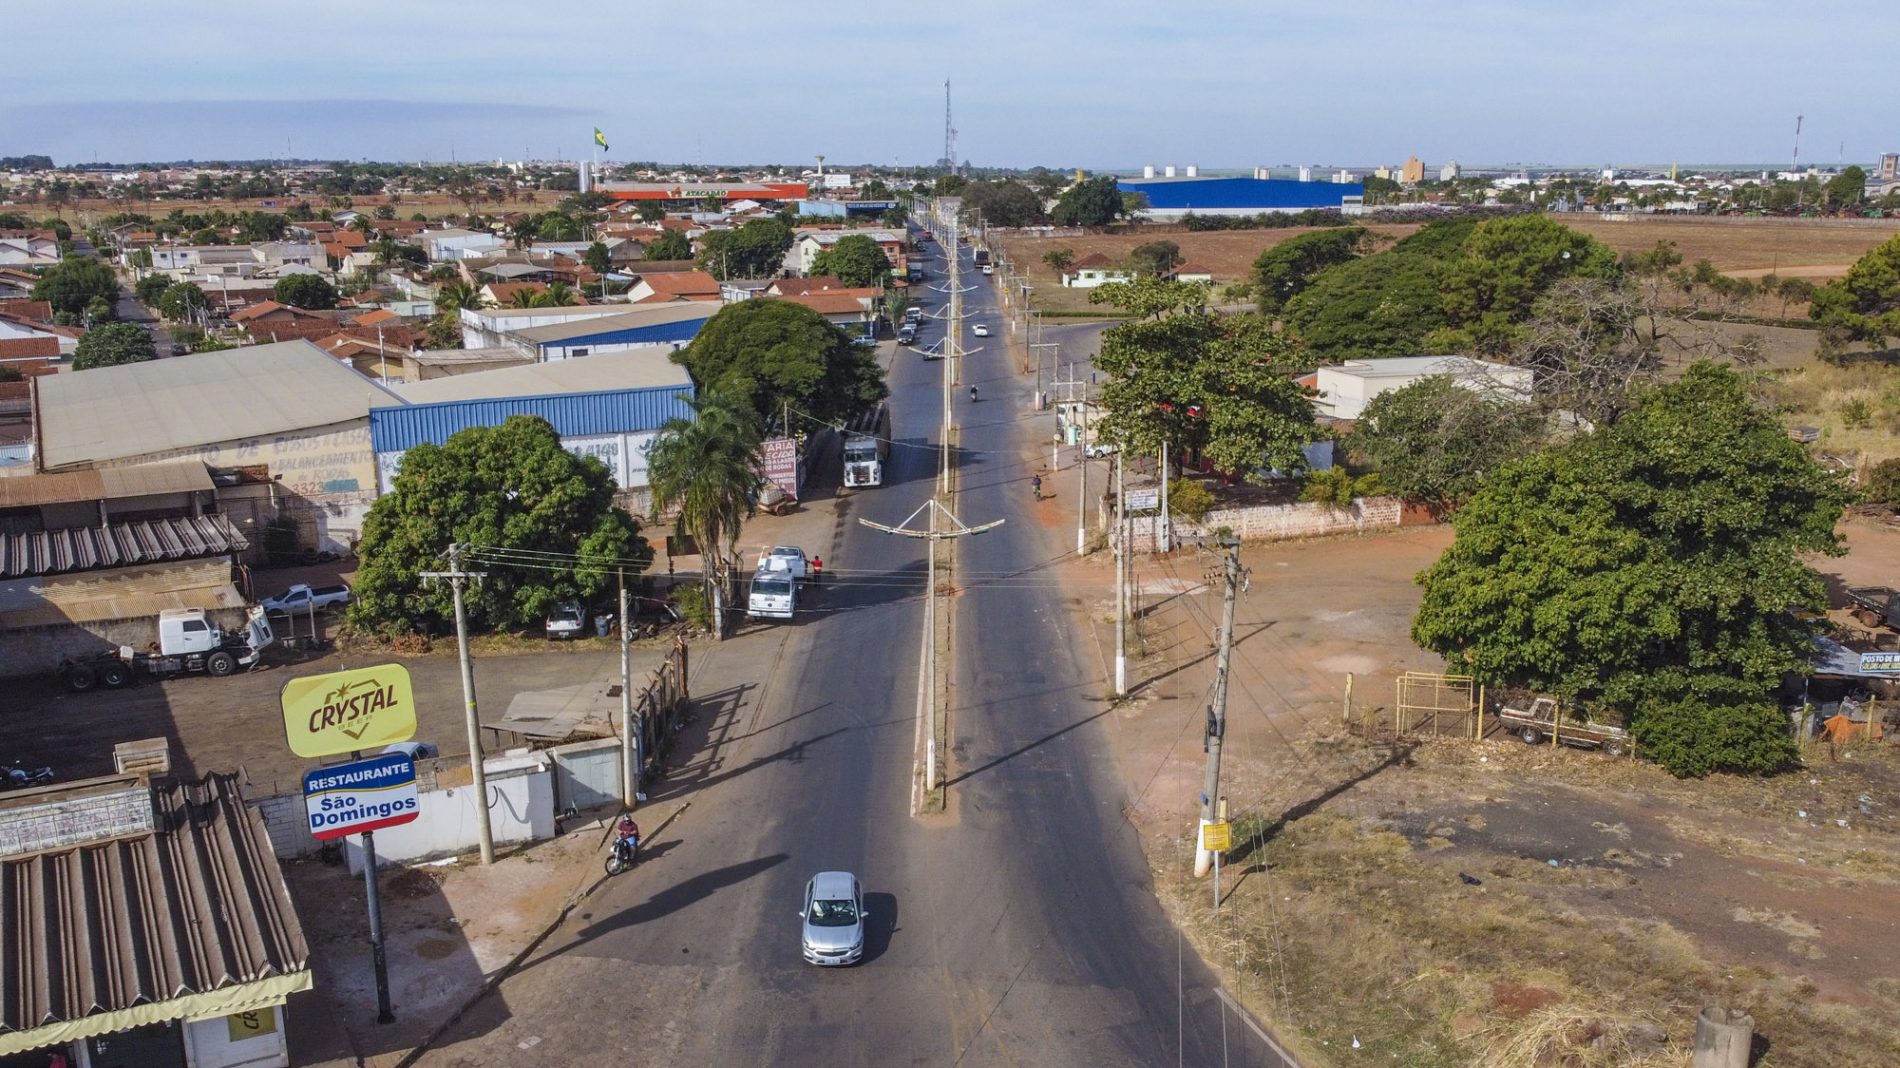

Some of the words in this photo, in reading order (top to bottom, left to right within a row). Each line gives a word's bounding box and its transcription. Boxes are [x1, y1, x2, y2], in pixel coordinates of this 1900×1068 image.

[237, 440, 260, 458] DE
[764, 451, 793, 460] ECIDO
[309, 685, 398, 733] CRYSTAL
[309, 763, 410, 791] RESTAURANTE
[310, 797, 416, 828] Domingos
[321, 796, 356, 812] São
[242, 1011, 260, 1030] CR
